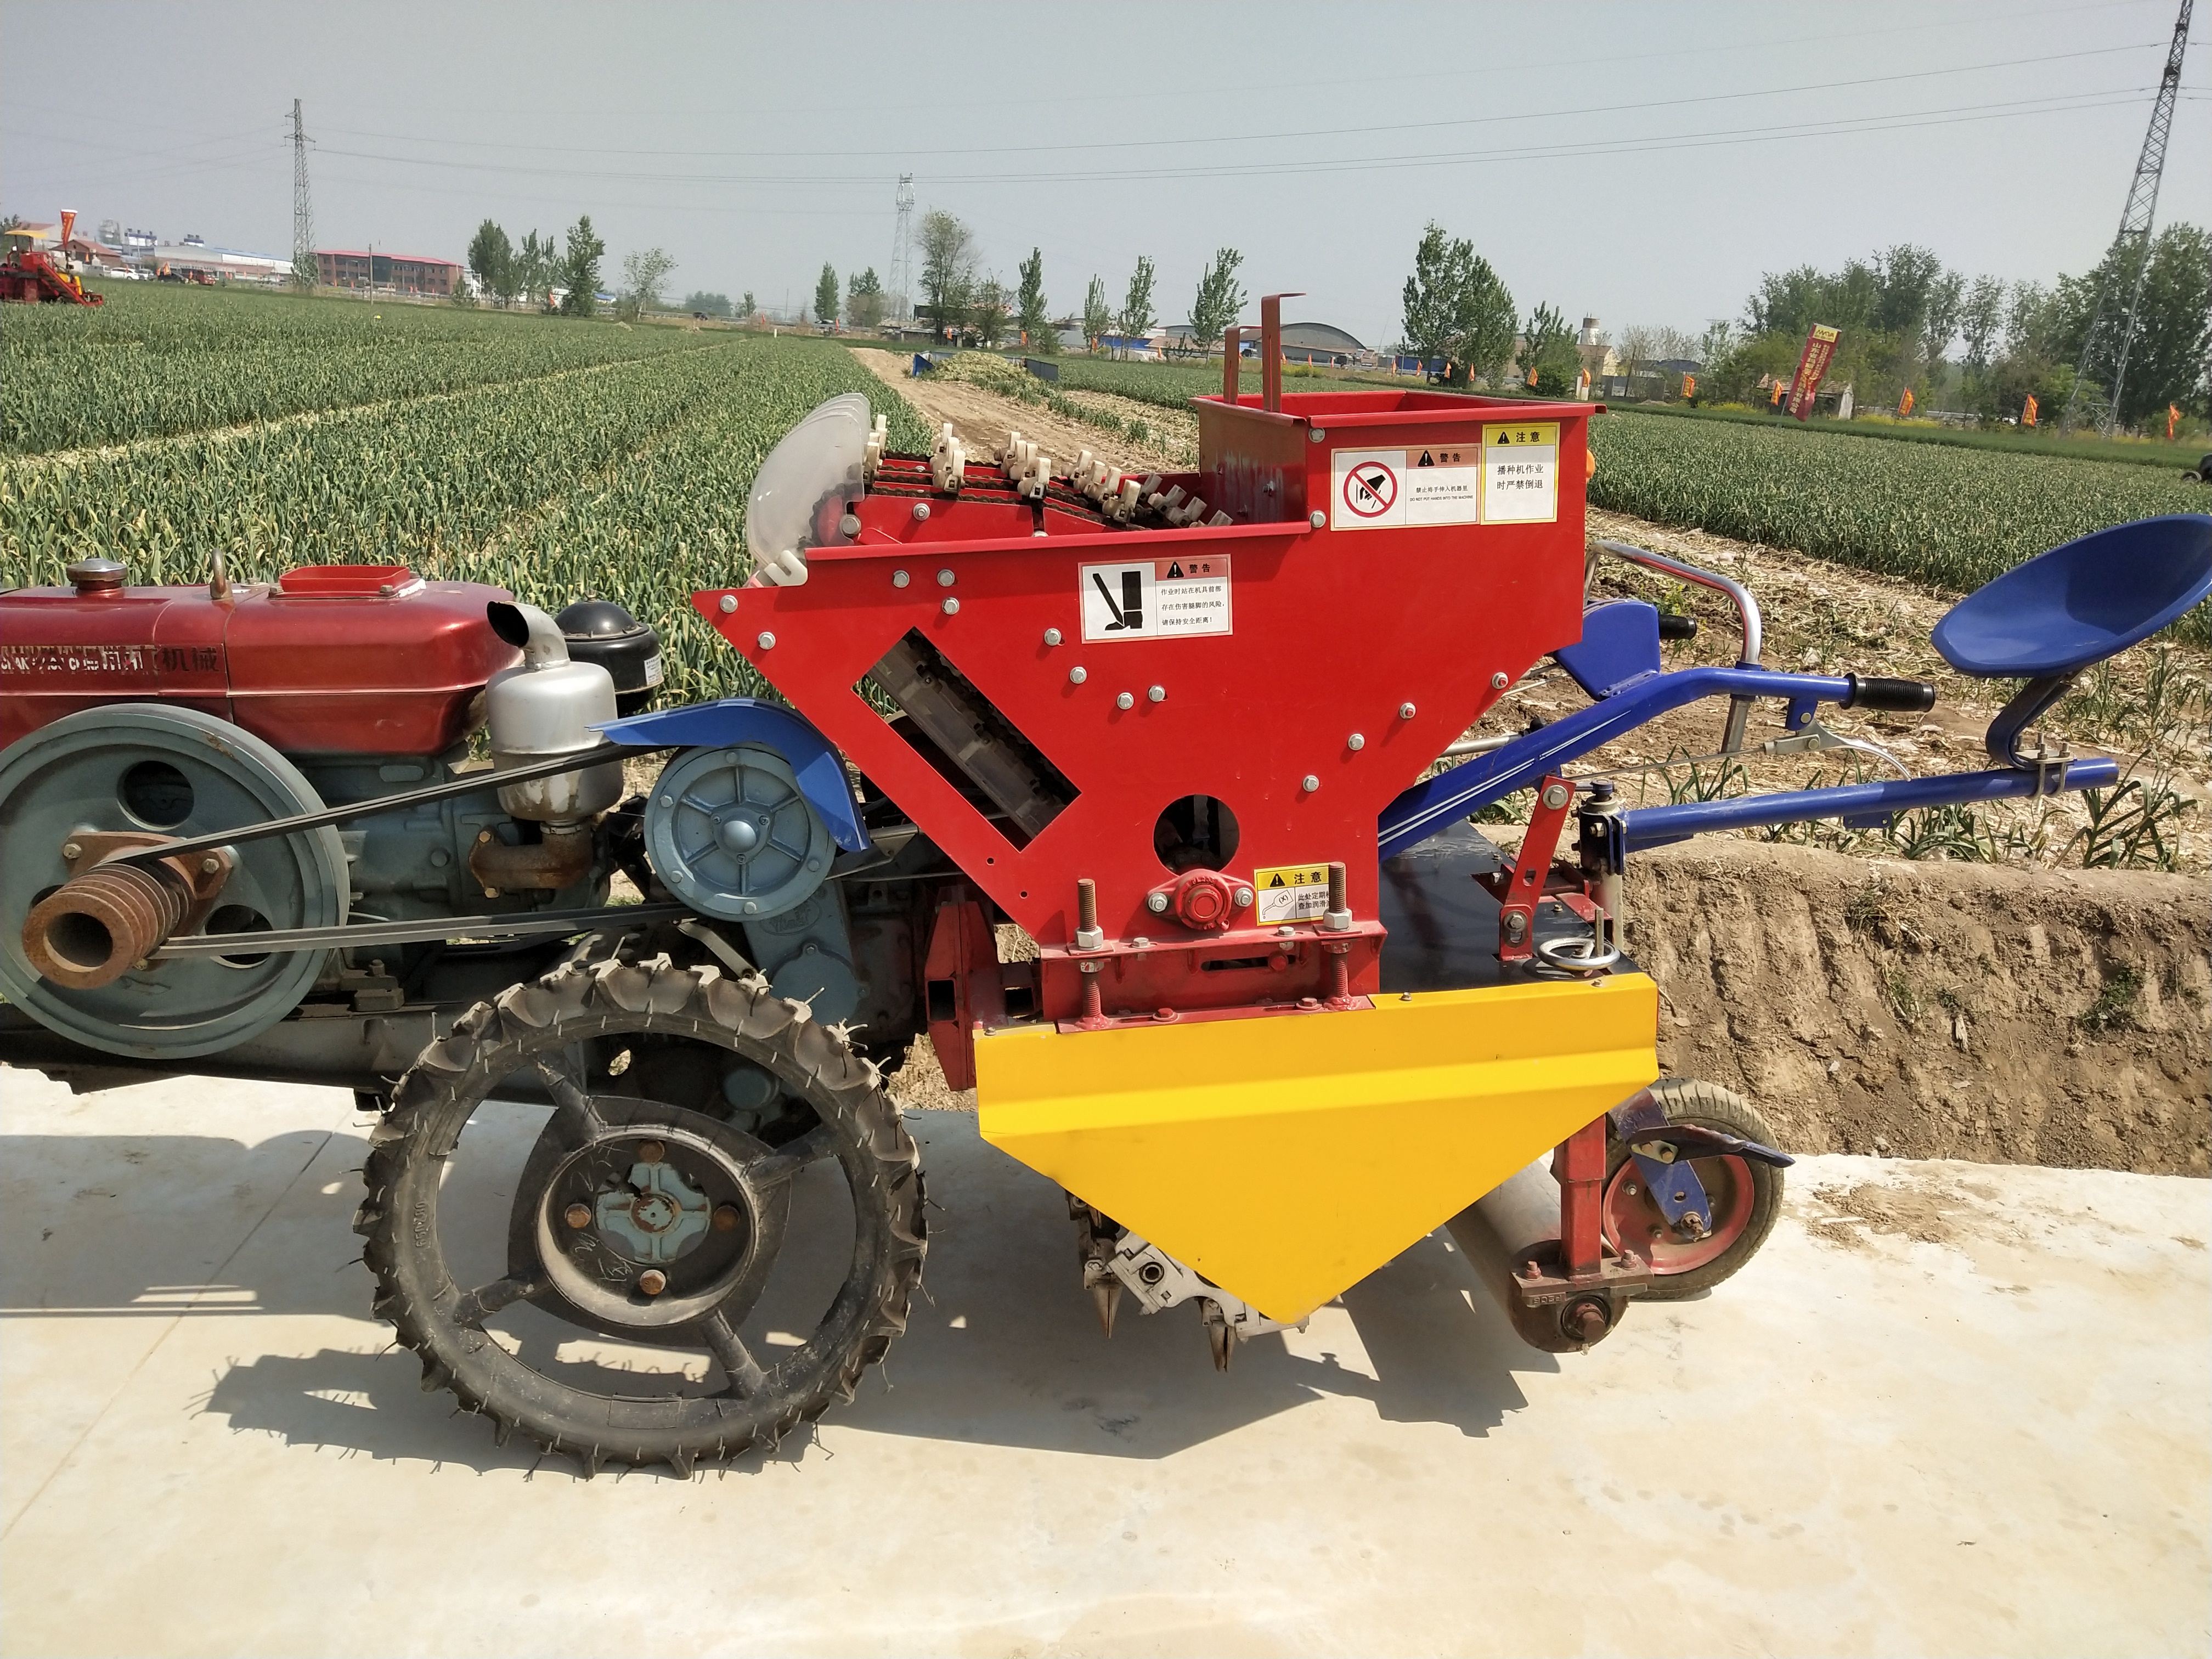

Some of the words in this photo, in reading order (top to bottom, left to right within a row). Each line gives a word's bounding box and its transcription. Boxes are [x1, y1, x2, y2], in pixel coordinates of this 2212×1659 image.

[1516, 431, 1540, 443] 注意
[1440, 453, 1461, 462] 警告
[1497, 464, 1544, 475] 播种机作业
[1416, 485, 1468, 493] 禁止将手伸入机器里
[1497, 479, 1543, 490] 时严禁倒退
[1189, 563, 1210, 574] 警告
[1160, 585, 1222, 596] 作业时站在机具前部
[161, 647, 219, 673] 机械
[1294, 871, 1322, 885] 注意
